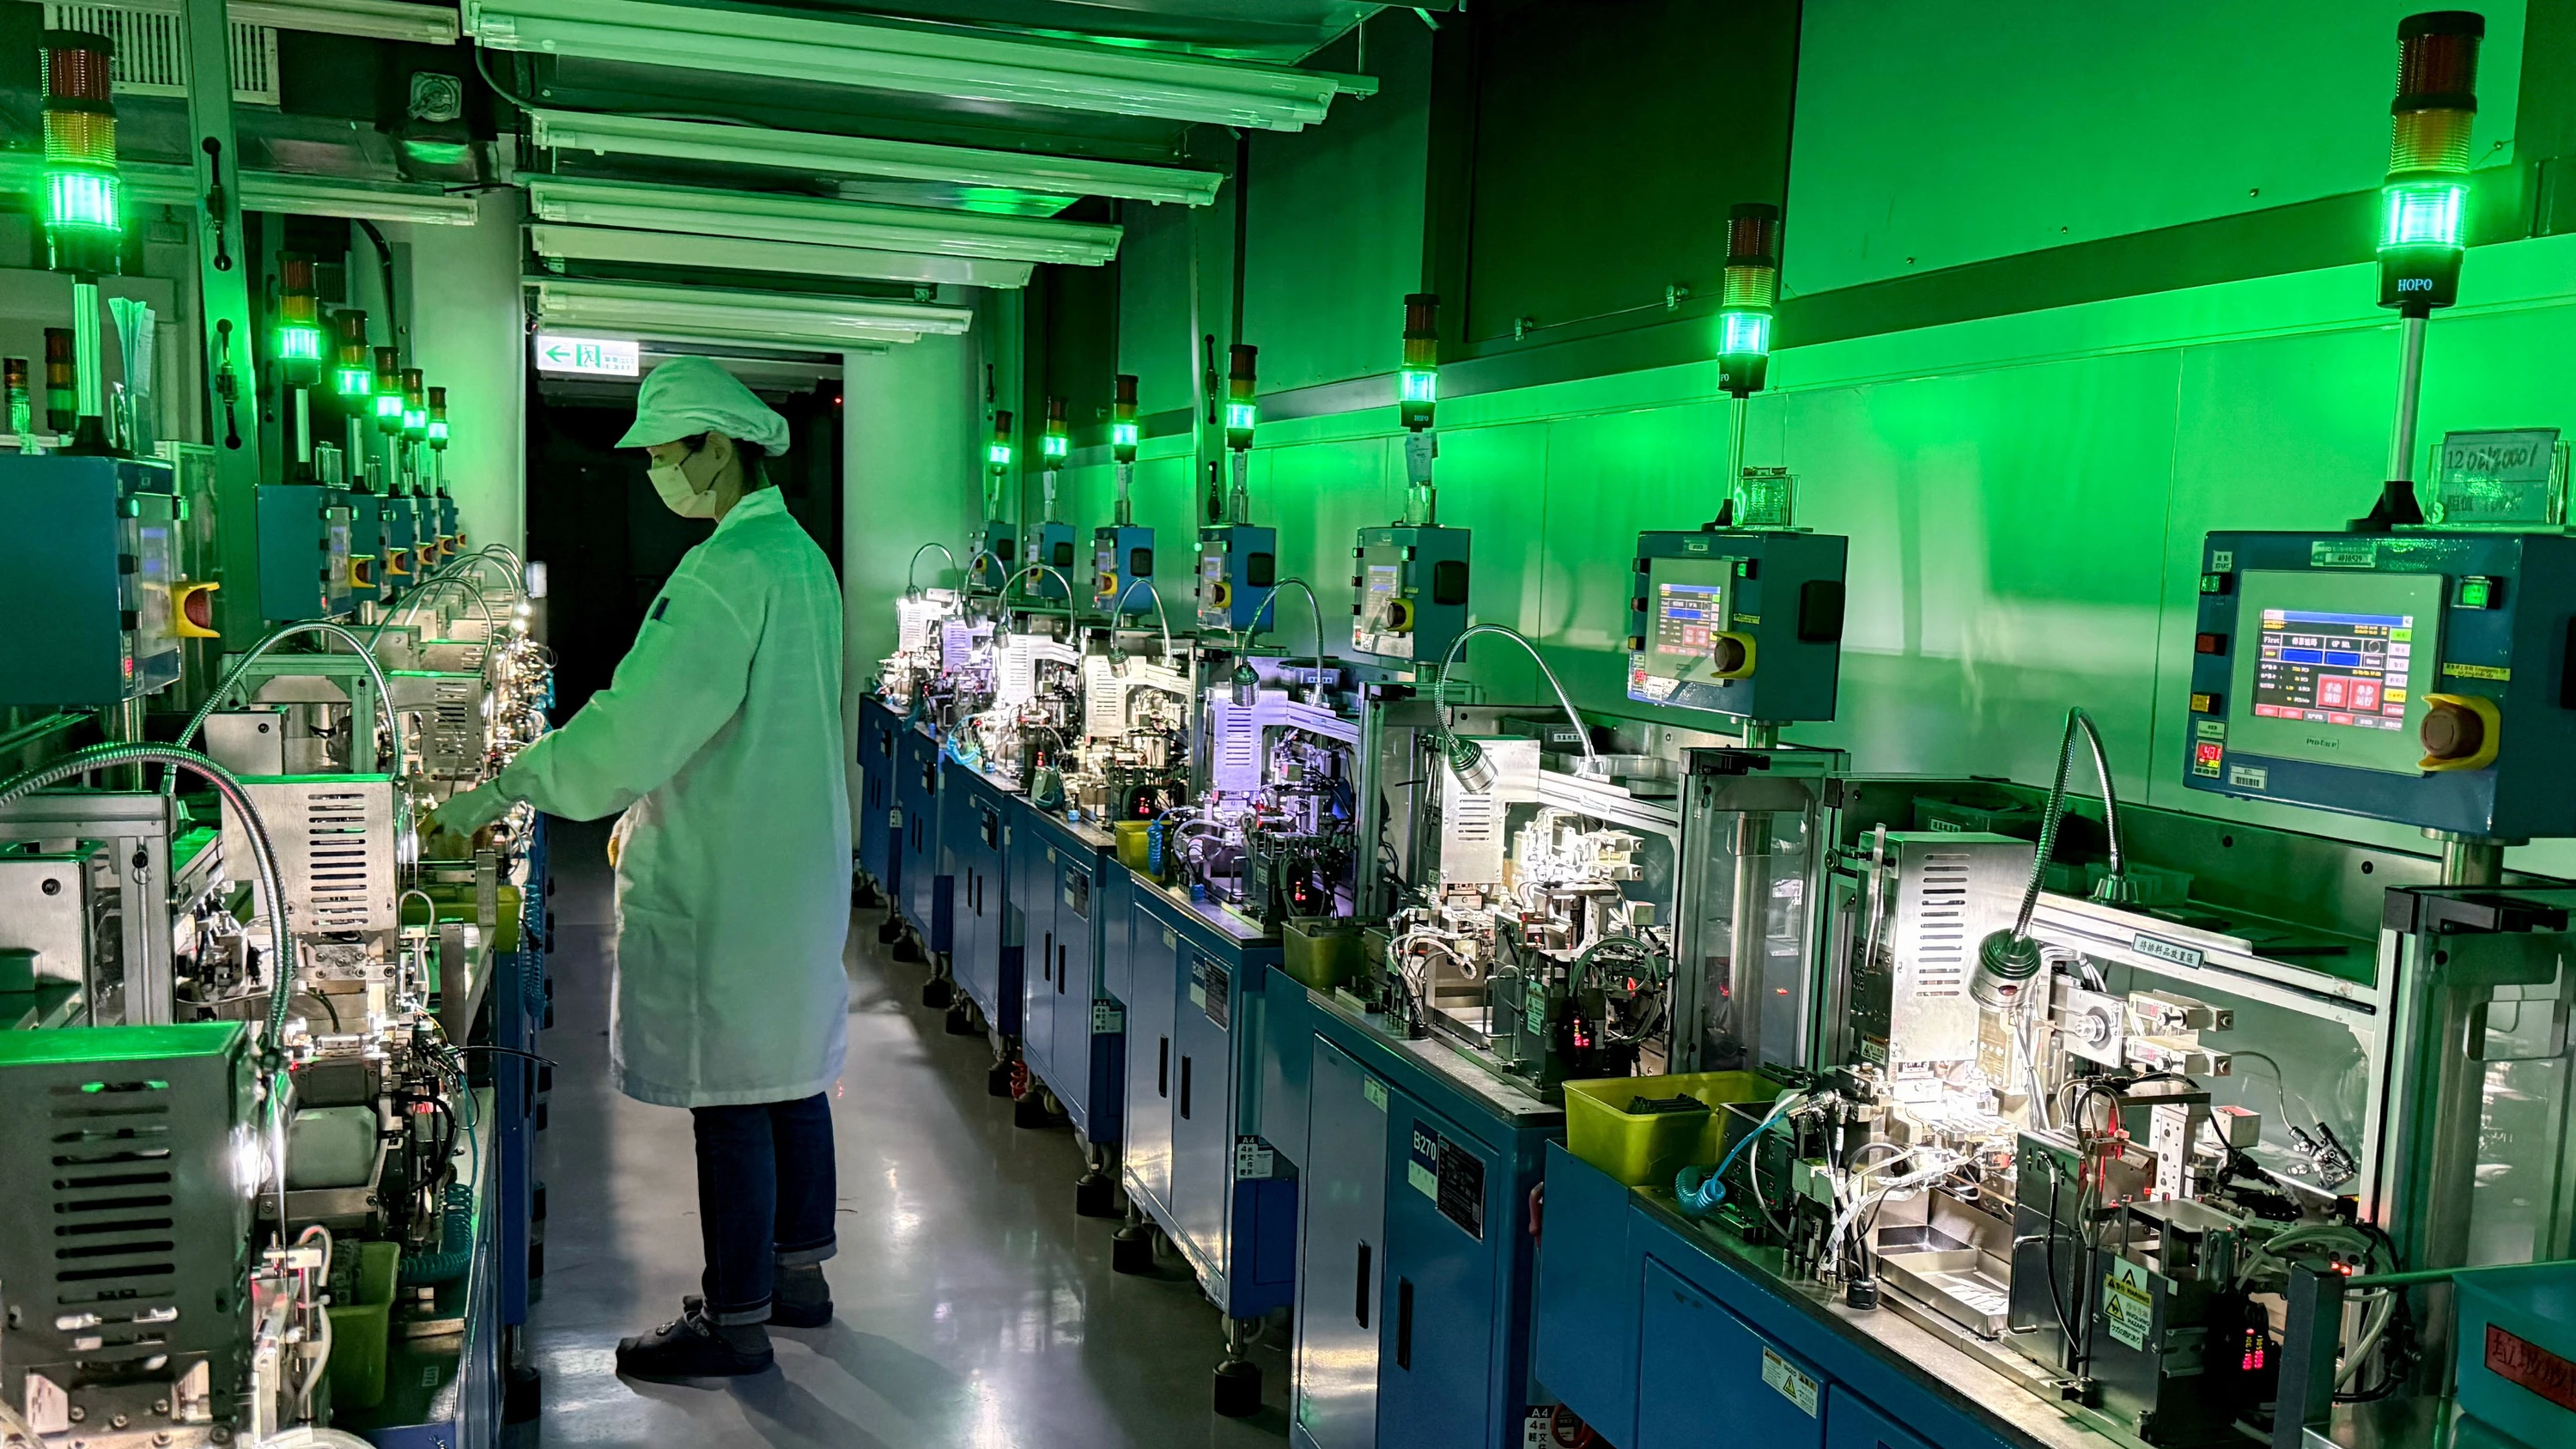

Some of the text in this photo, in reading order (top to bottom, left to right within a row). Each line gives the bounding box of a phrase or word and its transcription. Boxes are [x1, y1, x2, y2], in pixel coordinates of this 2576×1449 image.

[2397, 277, 2433, 292] HOPO
[1413, 1130, 1437, 1161] B270
[1531, 1408, 1548, 1418] A4
